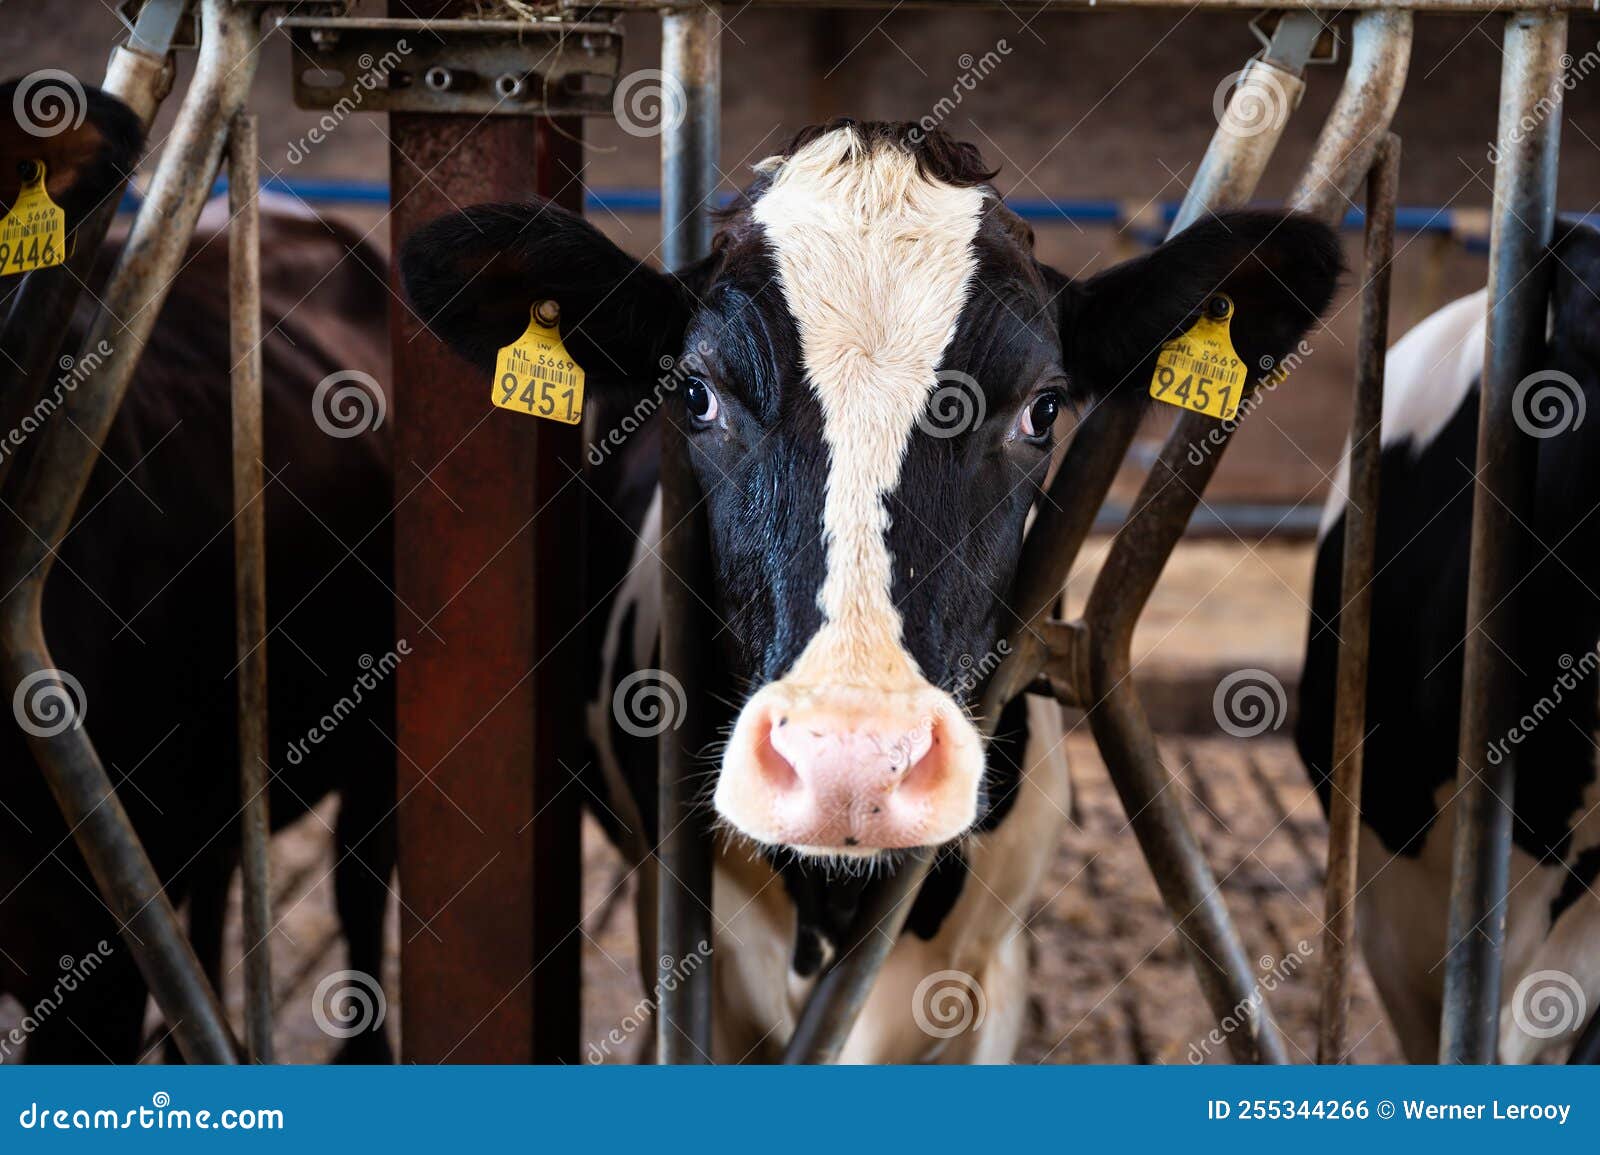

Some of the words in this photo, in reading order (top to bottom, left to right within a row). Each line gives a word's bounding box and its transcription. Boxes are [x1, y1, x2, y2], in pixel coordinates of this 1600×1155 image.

[28, 207, 55, 222] 5669
[0, 233, 55, 273] 9446
[513, 348, 530, 362] NL
[538, 354, 574, 371] 5669
[1177, 344, 1193, 357] NL
[1202, 350, 1238, 368] 5669
[501, 373, 574, 421] 9451
[1156, 367, 1231, 417] 9451
